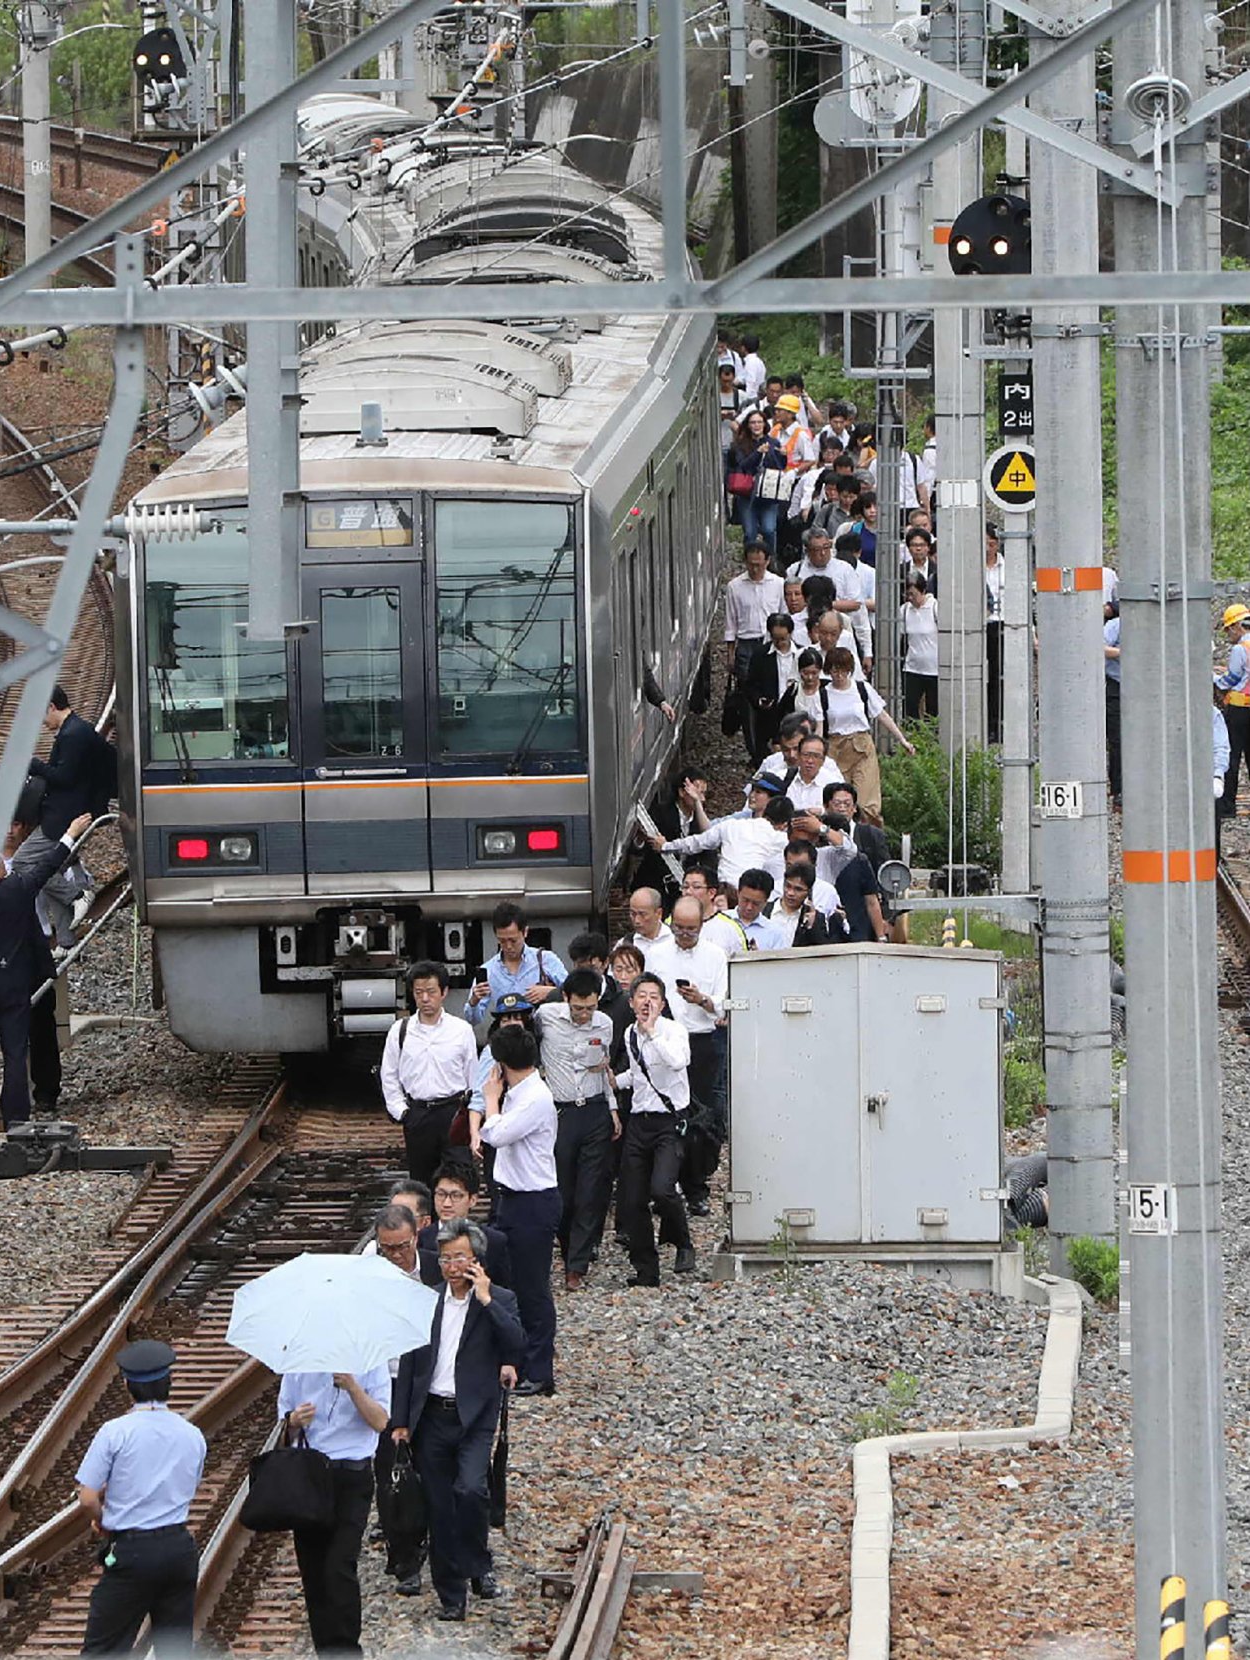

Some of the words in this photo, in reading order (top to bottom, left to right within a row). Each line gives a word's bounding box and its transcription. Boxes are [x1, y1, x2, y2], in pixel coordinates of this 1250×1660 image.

[1004, 383, 1030, 400] 内
[1004, 410, 1032, 427] 2出
[1009, 470, 1026, 488] 中
